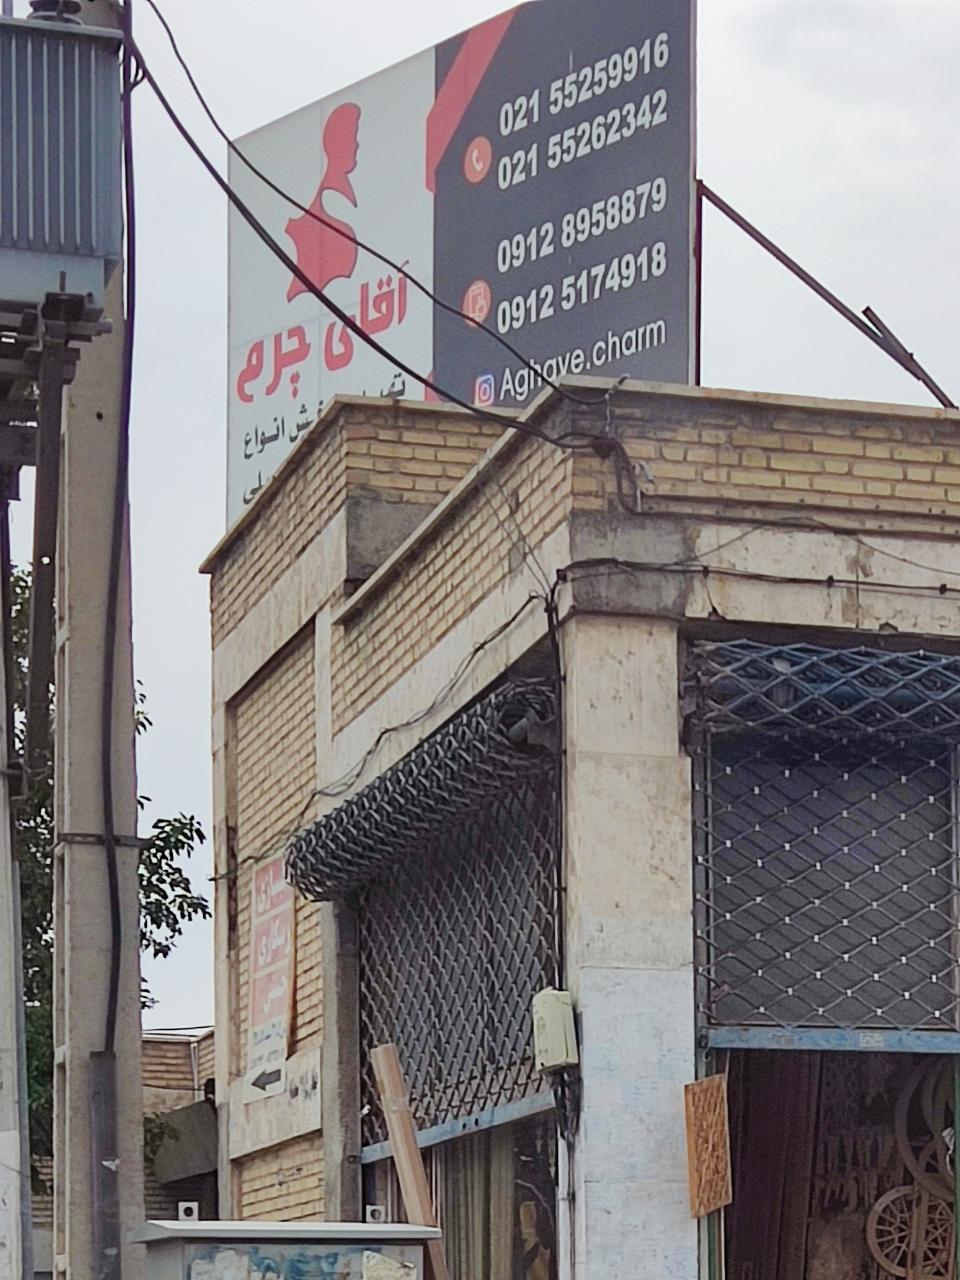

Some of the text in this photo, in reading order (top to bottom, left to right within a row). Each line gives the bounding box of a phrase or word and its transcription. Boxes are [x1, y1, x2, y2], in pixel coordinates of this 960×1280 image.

[499, 32, 669, 136] 021 55259916
[497, 89, 668, 190] 021 55262342
[497, 177, 667, 273] 0912 8958879
[497, 242, 667, 334] 0912 5174918
[236, 325, 312, 403] چرم
[244, 416, 286, 460] انواع
